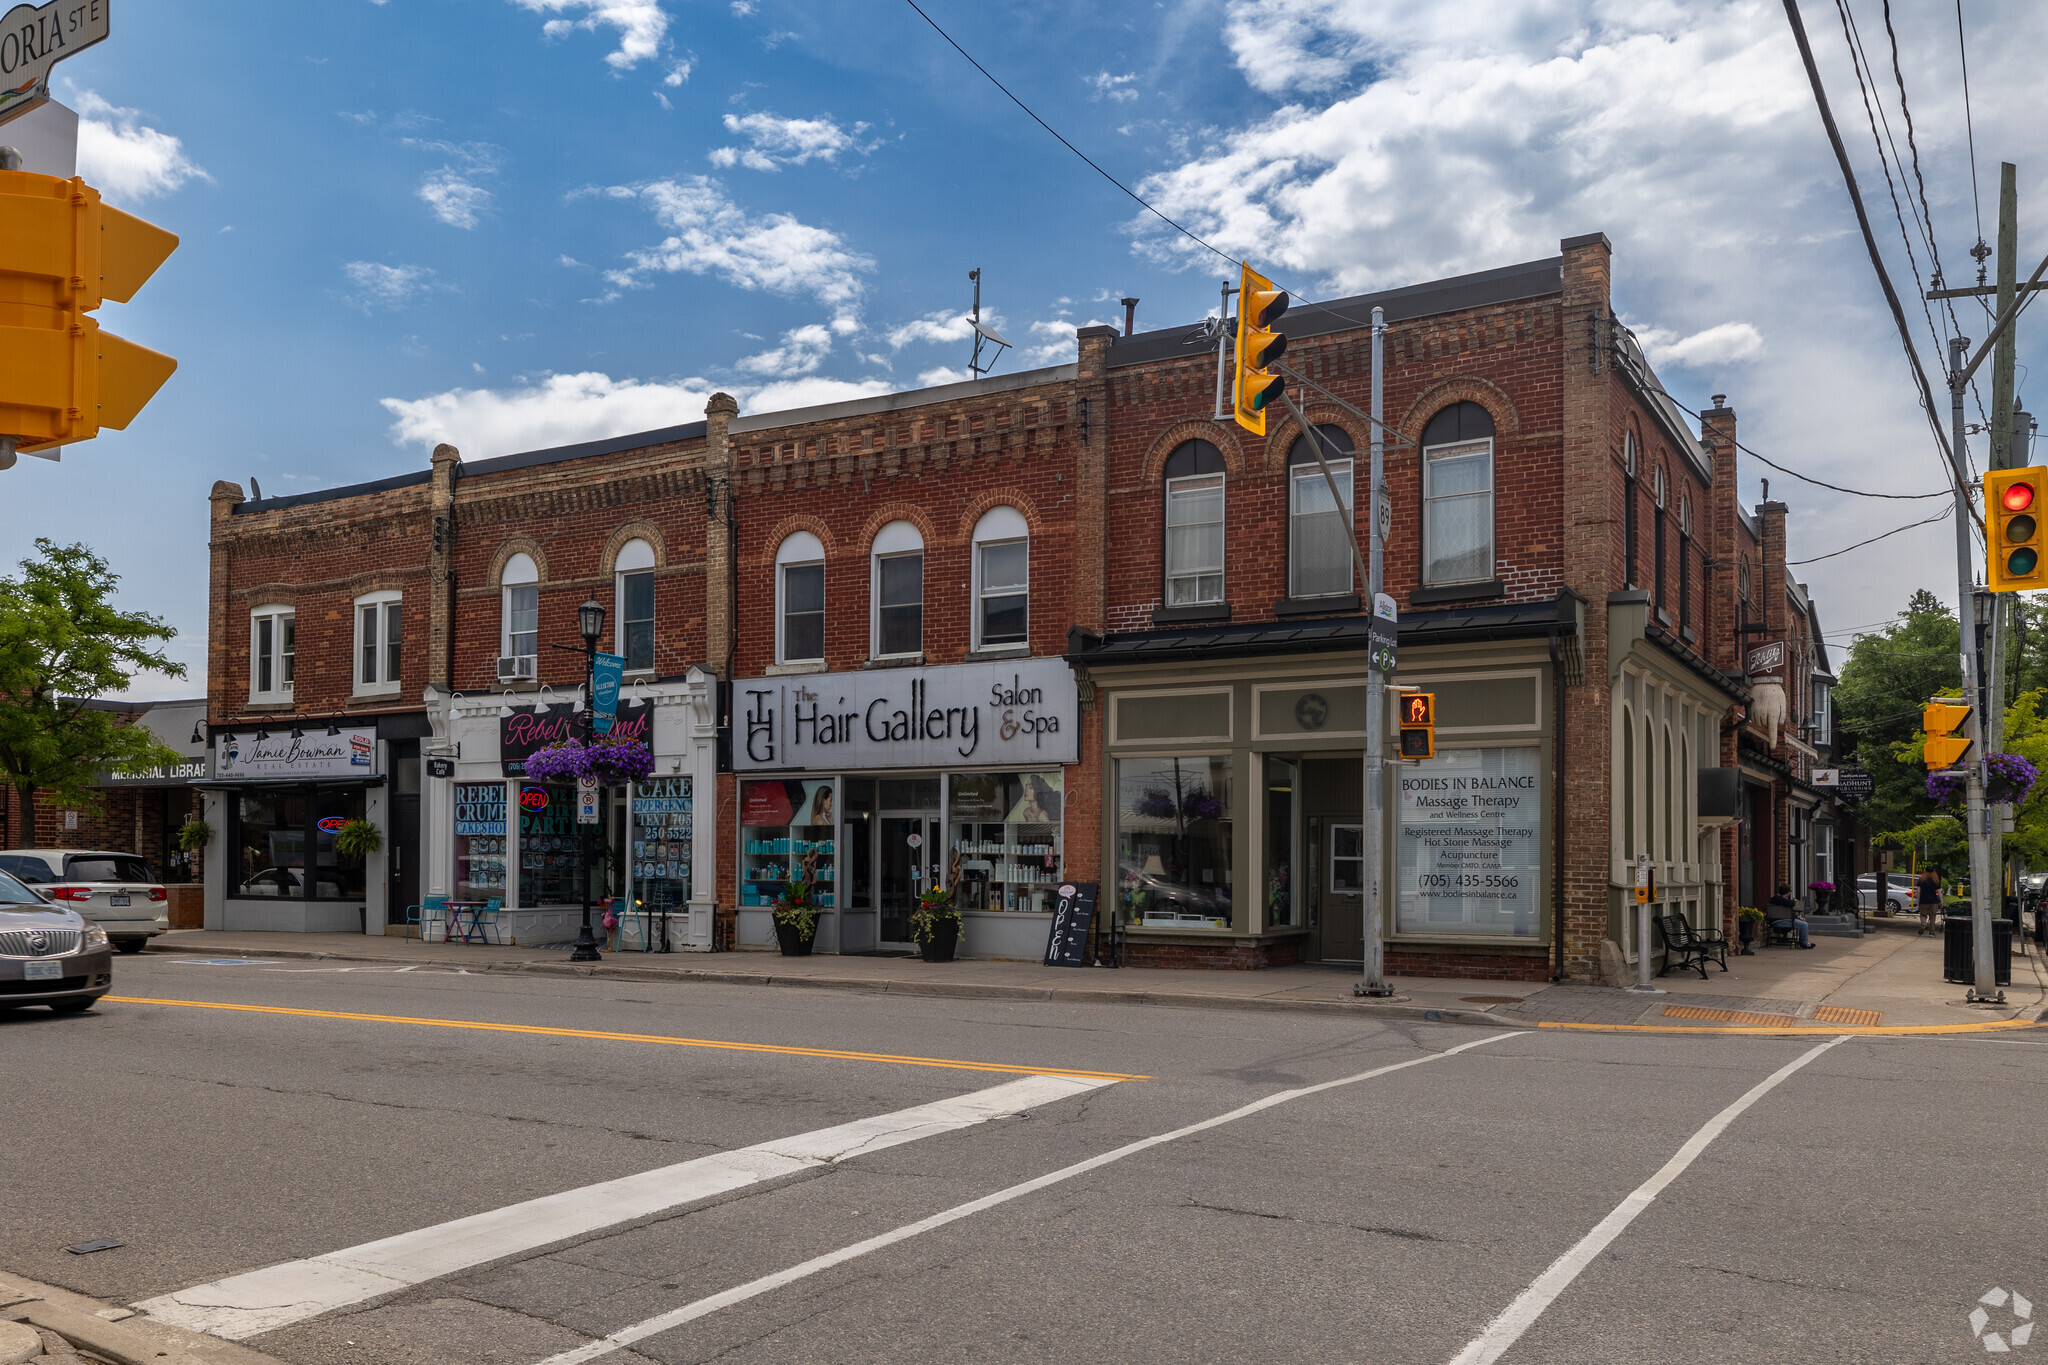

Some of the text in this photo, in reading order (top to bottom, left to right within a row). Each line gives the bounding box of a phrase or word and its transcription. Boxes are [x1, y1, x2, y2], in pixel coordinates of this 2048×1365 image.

[69, 6, 86, 32] ST
[91, 0, 99, 22] E
[1380, 505, 1389, 526] 89
[1372, 632, 1390, 648] Parking
[596, 656, 621, 668] Welcome
[1750, 648, 1781, 670] Schlitz
[793, 686, 817, 701] The
[990, 674, 1042, 706] Salon
[795, 678, 978, 757] Hair Gallery
[505, 713, 562, 745] Rebel
[1000, 709, 1059, 748] & Spa
[245, 738, 345, 764] Jamie Bowman
[434, 761, 447, 769] Bakery
[638, 778, 692, 798] CAKE
[1402, 776, 1535, 790] BODIES IN BALANCE
[456, 785, 506, 803] REBEL
[520, 792, 547, 806] OPEN
[552, 788, 569, 802] WE
[1416, 795, 1520, 809] Massage Therapy
[184, 813, 193, 826] 17
[456, 804, 506, 821] CRUMB
[639, 813, 692, 826] TEXT 705
[1480, 810, 1505, 818] Centre
[645, 827, 692, 839] 250-5522
[1404, 827, 1533, 838] Registered Massage Therapy
[1424, 838, 1512, 848] Hot Stone Massage
[1440, 850, 1498, 860] Acupuncture
[1418, 874, 1518, 888] (705) 435-5566
[1420, 889, 1517, 899] www.bodiesinbalance.ca
